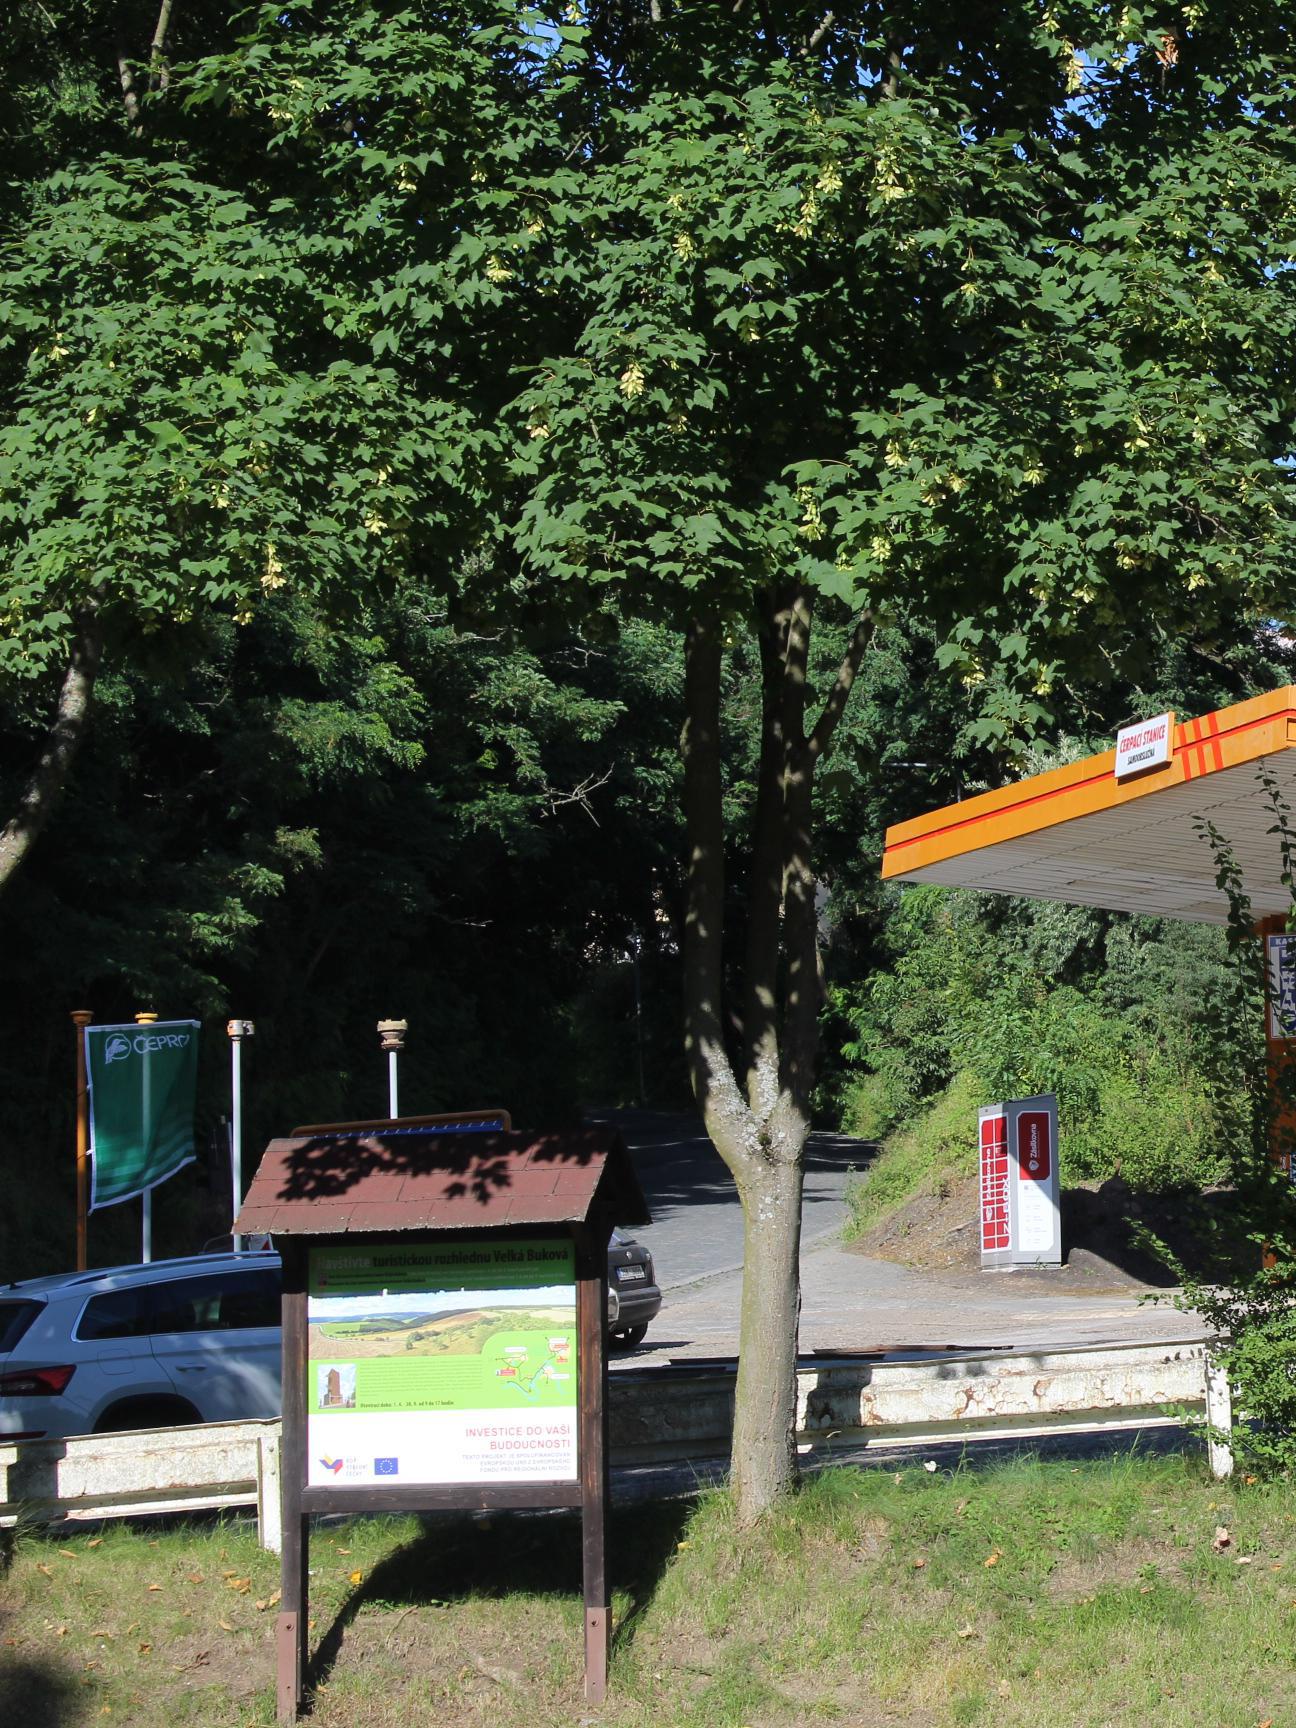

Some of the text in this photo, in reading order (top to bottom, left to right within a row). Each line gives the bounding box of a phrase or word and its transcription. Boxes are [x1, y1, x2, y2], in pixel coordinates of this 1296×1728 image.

[1120, 722, 1166, 753] ČERPACÍ STANICE
[133, 1035, 189, 1054] ČEPRO
[372, 1252, 432, 1268] turistickou
[434, 1250, 490, 1266] rozhlednu
[492, 1249, 524, 1263] Velká
[527, 1246, 568, 1262] Buková
[466, 1426, 522, 1438] INVESTICE
[526, 1426, 542, 1436] DO
[490, 1439, 571, 1451] BUDOUCNOSTI
